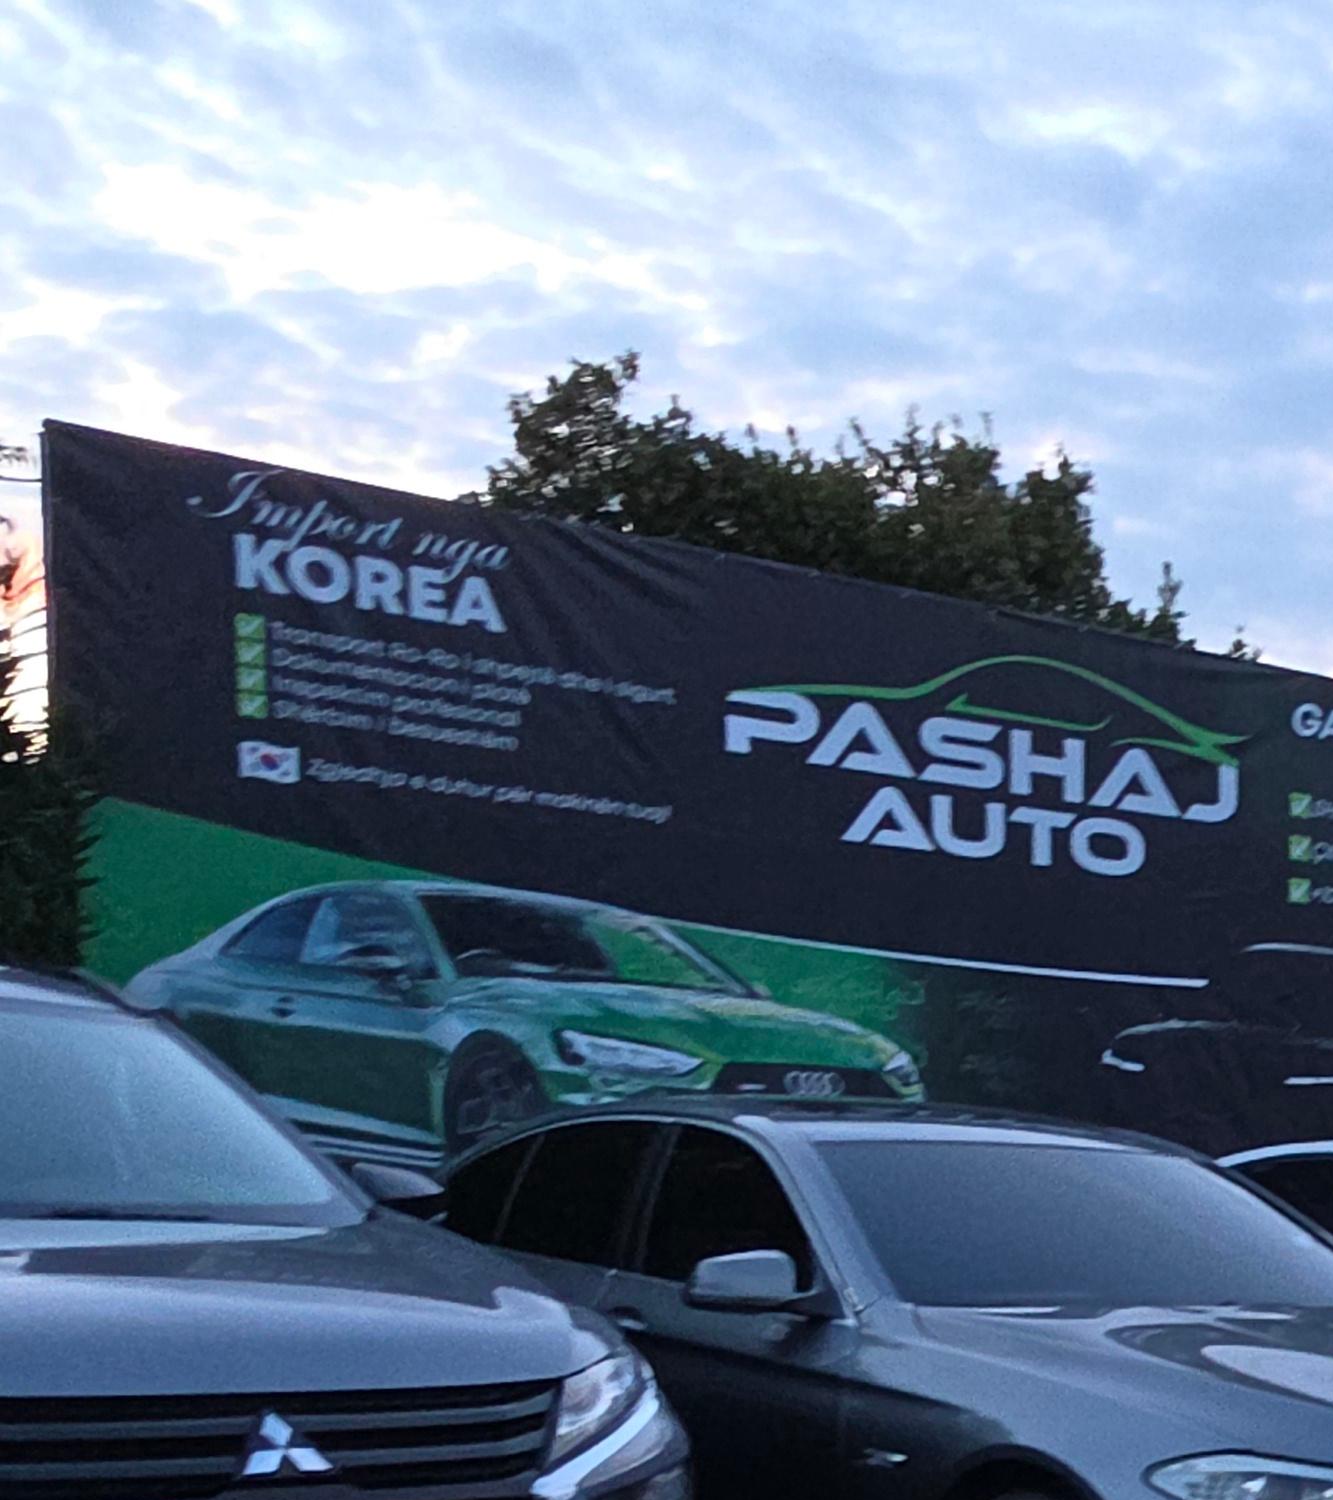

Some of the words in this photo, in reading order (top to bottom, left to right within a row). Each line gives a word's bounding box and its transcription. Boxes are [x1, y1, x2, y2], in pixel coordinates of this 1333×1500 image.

[186, 468, 404, 552] Import
[412, 529, 509, 584] nga
[232, 532, 508, 634] KOREA
[723, 689, 1239, 823] PASHAJ
[839, 786, 1147, 877] AUTO
